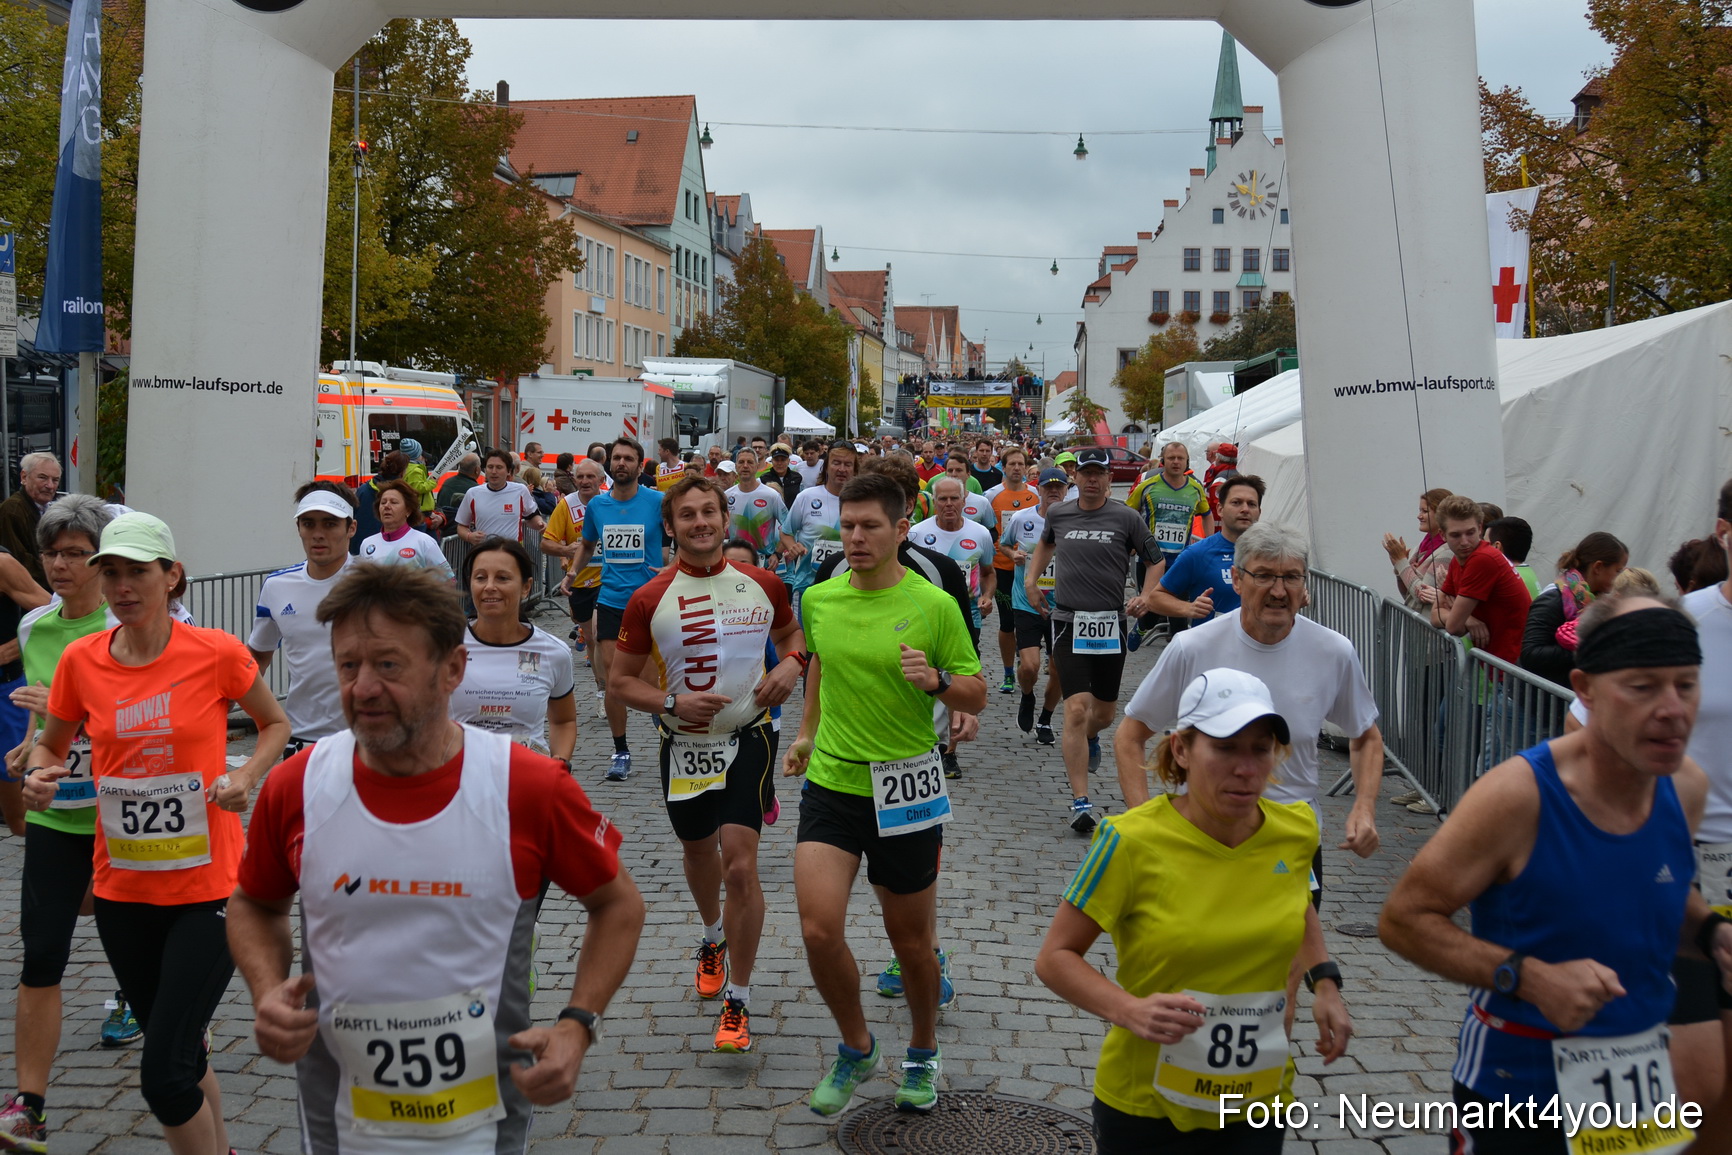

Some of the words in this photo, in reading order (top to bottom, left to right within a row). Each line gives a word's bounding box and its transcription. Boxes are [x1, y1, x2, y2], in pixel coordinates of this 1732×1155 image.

[132, 375, 283, 394] www.bmw-laufsport.de
[1334, 376, 1495, 397] www.bmw-laufsport.de
[954, 398, 983, 406] START
[572, 409, 612, 418] Bayerisches
[607, 534, 641, 549] 2276
[1158, 529, 1184, 543] 3116
[721, 607, 750, 615] FITNESS
[1078, 621, 1115, 638] 2607
[116, 691, 172, 732] RUNWAY
[684, 751, 726, 775] 355
[873, 763, 901, 774] PARTL
[902, 756, 934, 770] Neumarkt
[100, 785, 131, 797] PARTL
[132, 784, 184, 798] Neumarkt
[882, 766, 941, 806] 2033
[121, 797, 185, 835] 523
[906, 806, 931, 822] Chris
[119, 842, 181, 854] KRISZTINA
[369, 878, 472, 898] KLEBL
[334, 1016, 384, 1032] PARTL
[387, 1009, 464, 1032] Neumarkt
[1206, 1022, 1260, 1069] 85
[366, 1031, 467, 1088] 259
[1194, 1077, 1253, 1096] Marion
[1592, 1058, 1663, 1118] 116
[390, 1097, 456, 1120] Rainer
